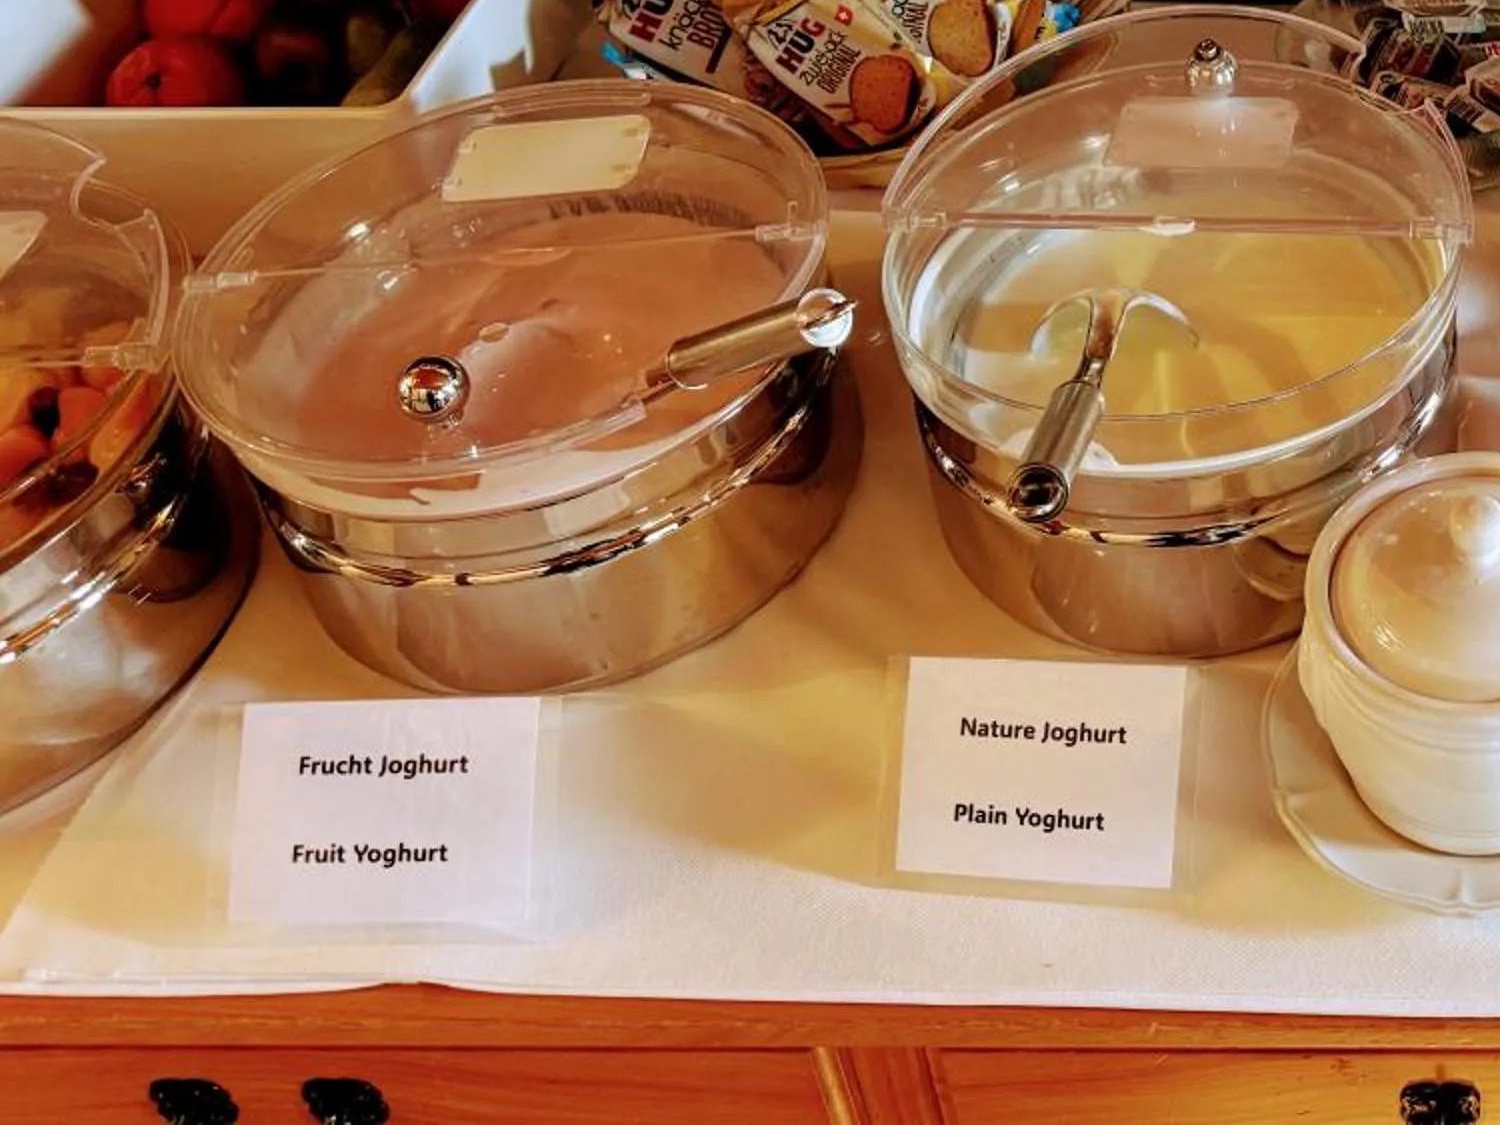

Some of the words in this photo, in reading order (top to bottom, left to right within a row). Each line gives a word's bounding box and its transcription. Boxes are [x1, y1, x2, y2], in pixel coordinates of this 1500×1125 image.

[775, 18, 827, 74] HUG
[960, 716, 1036, 740] Nature
[1041, 722, 1127, 747] Joghurt
[300, 754, 373, 775] Frucht
[378, 753, 469, 780] Joghurt
[953, 803, 1007, 825] Plain
[1015, 807, 1105, 833] Yoghurt
[292, 843, 346, 863] Fruit
[354, 843, 448, 868] Yoghurt
